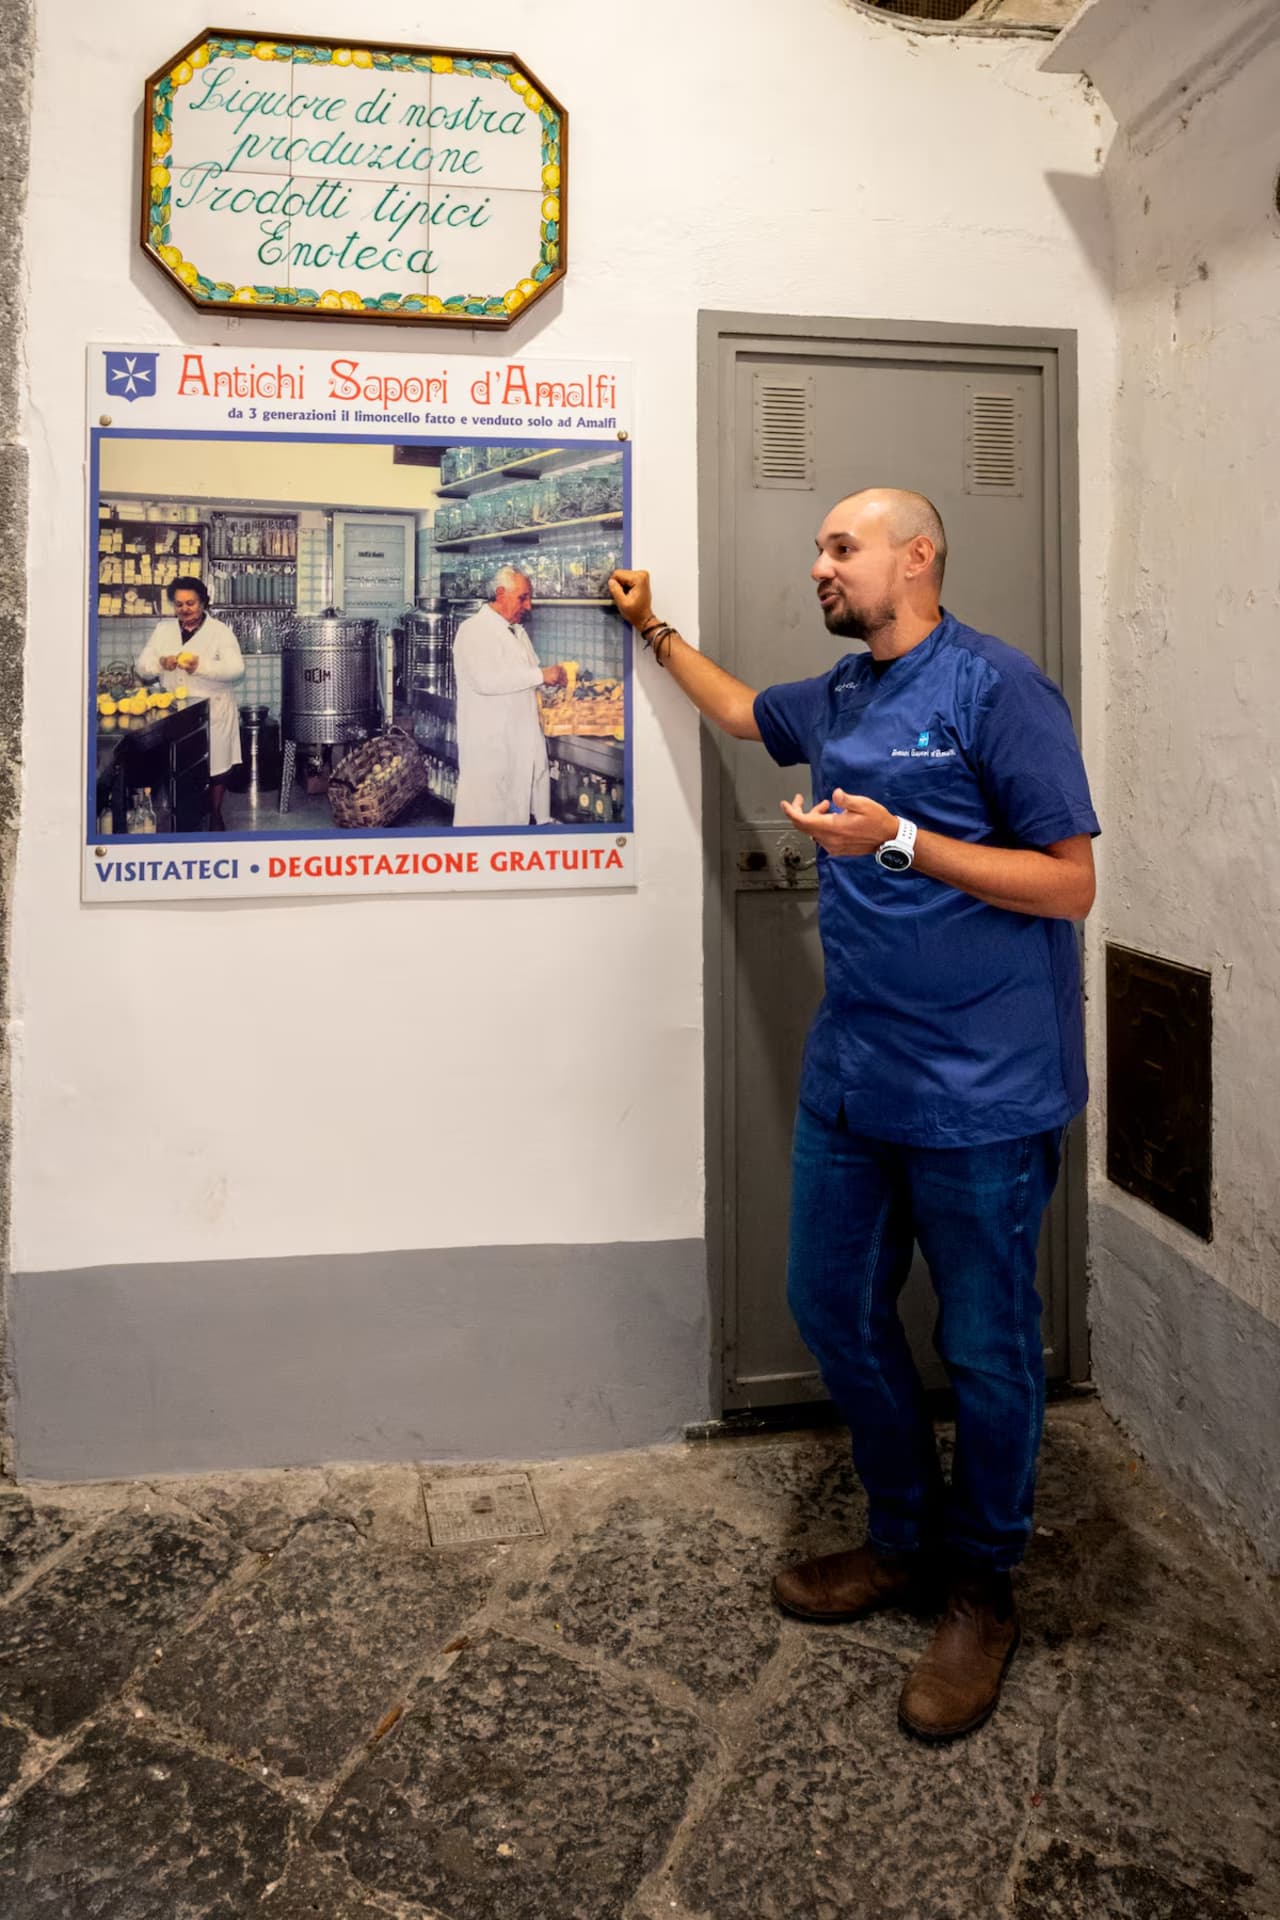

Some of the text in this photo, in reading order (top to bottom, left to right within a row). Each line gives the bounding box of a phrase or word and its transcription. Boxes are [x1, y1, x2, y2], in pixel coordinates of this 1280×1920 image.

[189, 66, 526, 135] Liquore di nostra
[226, 131, 483, 174] produzione
[175, 161, 493, 242] Prodotti tipici
[257, 219, 440, 274] Enoteca
[177, 354, 616, 410] Antichi Sapori d'Amalfi
[228, 408, 617, 428] da 3 generazioni il limoncello fatto e venduto solo ad Amalfi
[96, 848, 624, 882] VISITATECI DEGUSTAZIONE GRATUITA
